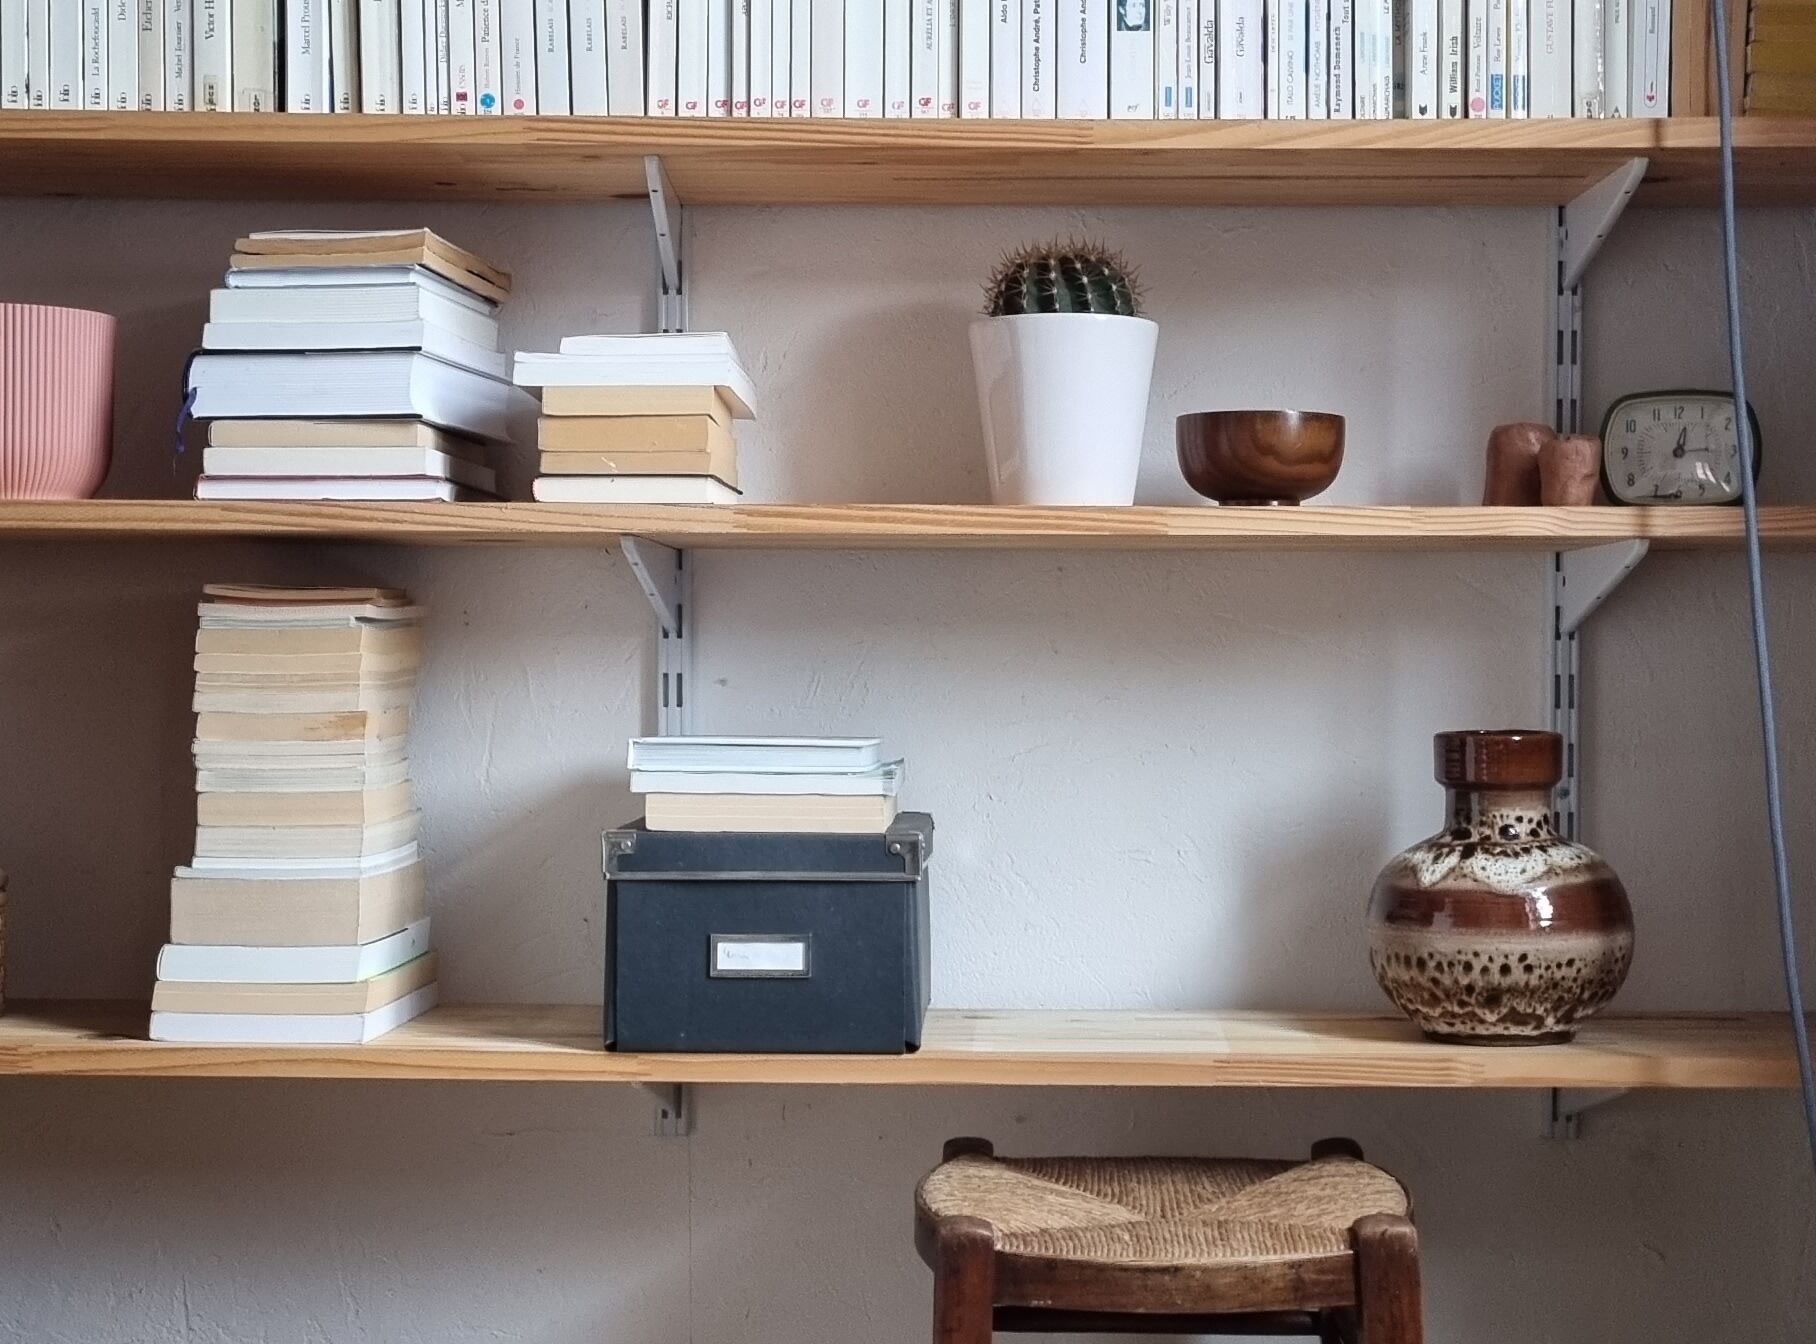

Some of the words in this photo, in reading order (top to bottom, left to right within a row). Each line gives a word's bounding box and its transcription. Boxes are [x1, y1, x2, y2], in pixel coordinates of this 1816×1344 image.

[926, 7, 932, 16] ET
[1384, 6, 1389, 14] LE
[204, 12, 215, 40] Victor
[481, 8, 490, 43] Patience
[1473, 16, 1482, 49] Voltaire
[1546, 12, 1554, 54] GUSTAVE
[301, 26, 310, 55] Marcel
[1204, 20, 1214, 64] Gavalda
[1449, 36, 1458, 56] Irish
[1333, 26, 1341, 70] Domenech
[91, 66, 100, 76] La
[1033, 46, 1041, 92] Christophe
[1449, 61, 1458, 93] William
[1334, 74, 1342, 113] Raymond
[1493, 74, 1501, 109] POCKET
[919, 98, 931, 107] GF
[1652, 408, 1661, 422] 11
[1674, 407, 1684, 419] 12
[1700, 406, 1704, 418] 1
[1625, 420, 1636, 432] 10
[1724, 418, 1732, 430] 2
[1621, 446, 1628, 460] 9
[1730, 444, 1736, 458] 3
[1627, 473, 1636, 487] 8
[1724, 472, 1731, 484] 4
[1698, 485, 1705, 496] 5
